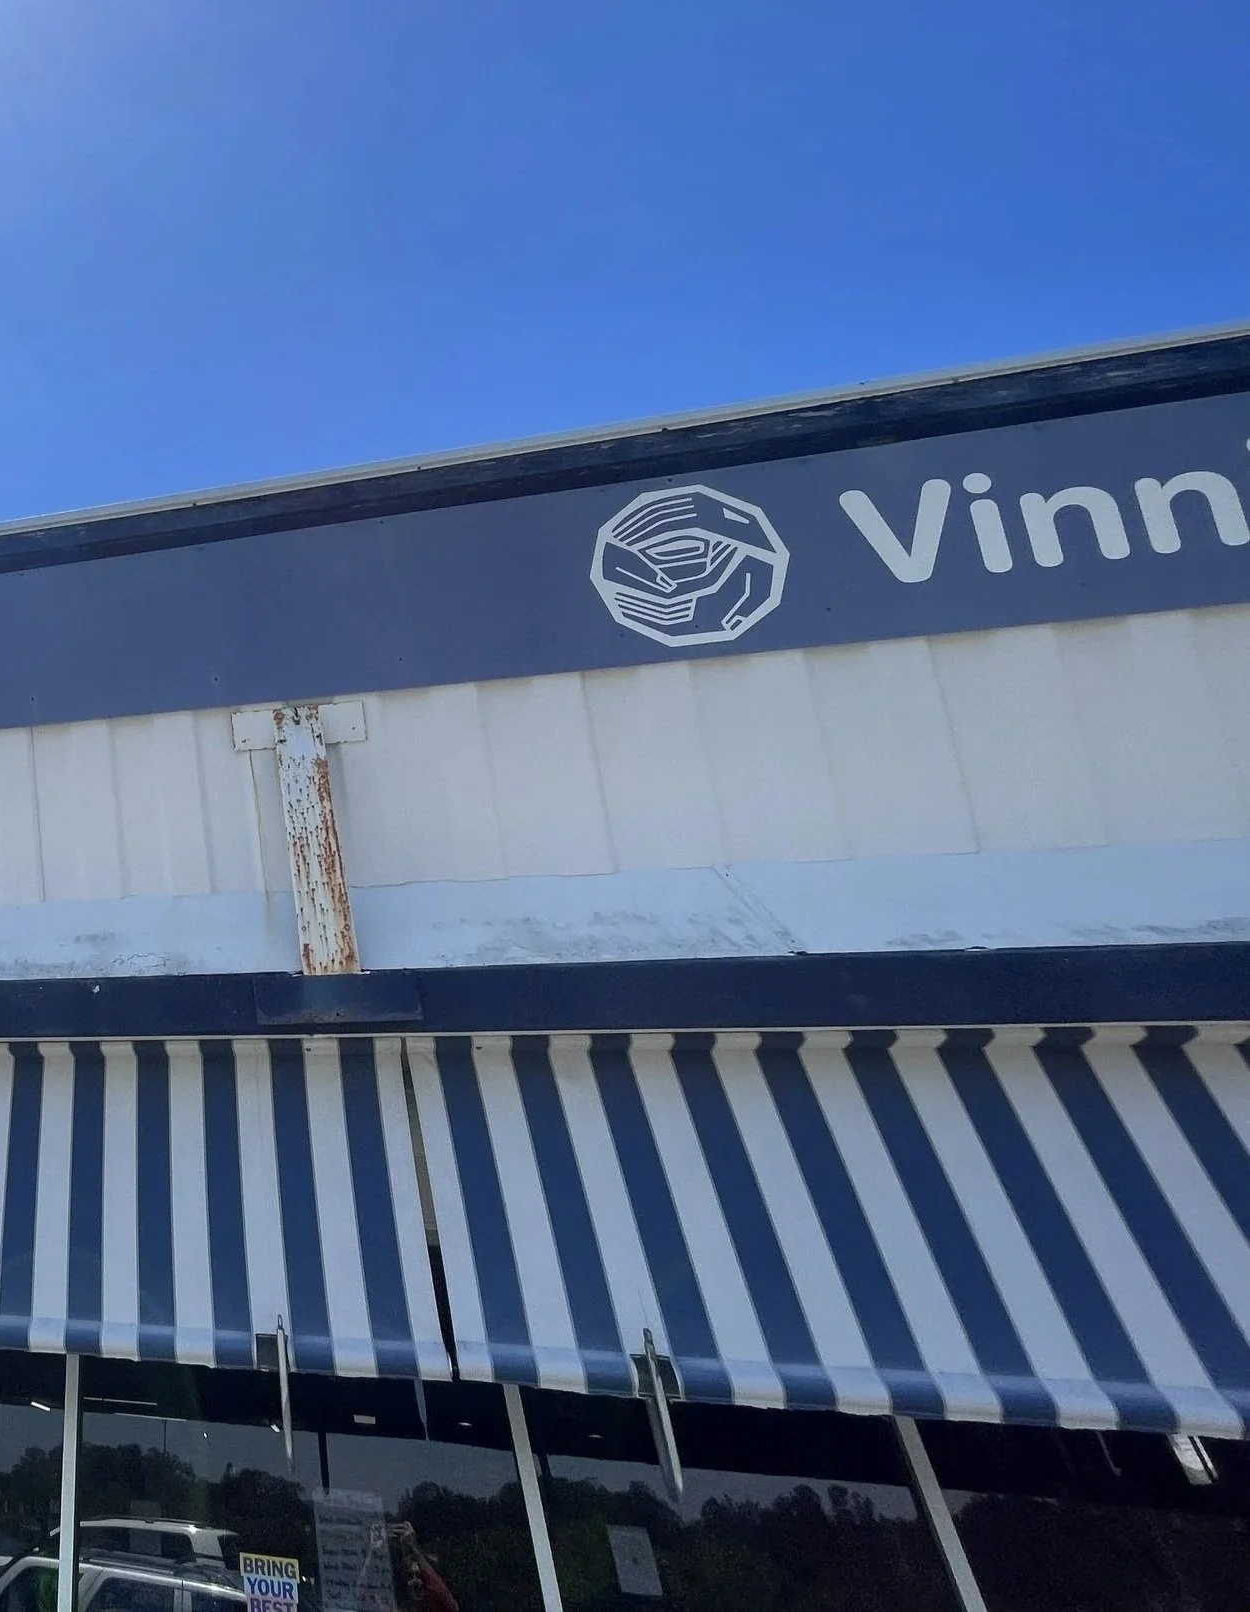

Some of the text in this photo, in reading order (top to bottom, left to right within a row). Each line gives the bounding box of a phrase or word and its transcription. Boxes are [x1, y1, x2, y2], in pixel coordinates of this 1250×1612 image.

[839, 438, 1250, 583] Vinn
[243, 1556, 297, 1580] BRING
[247, 1577, 294, 1600] YOUR
